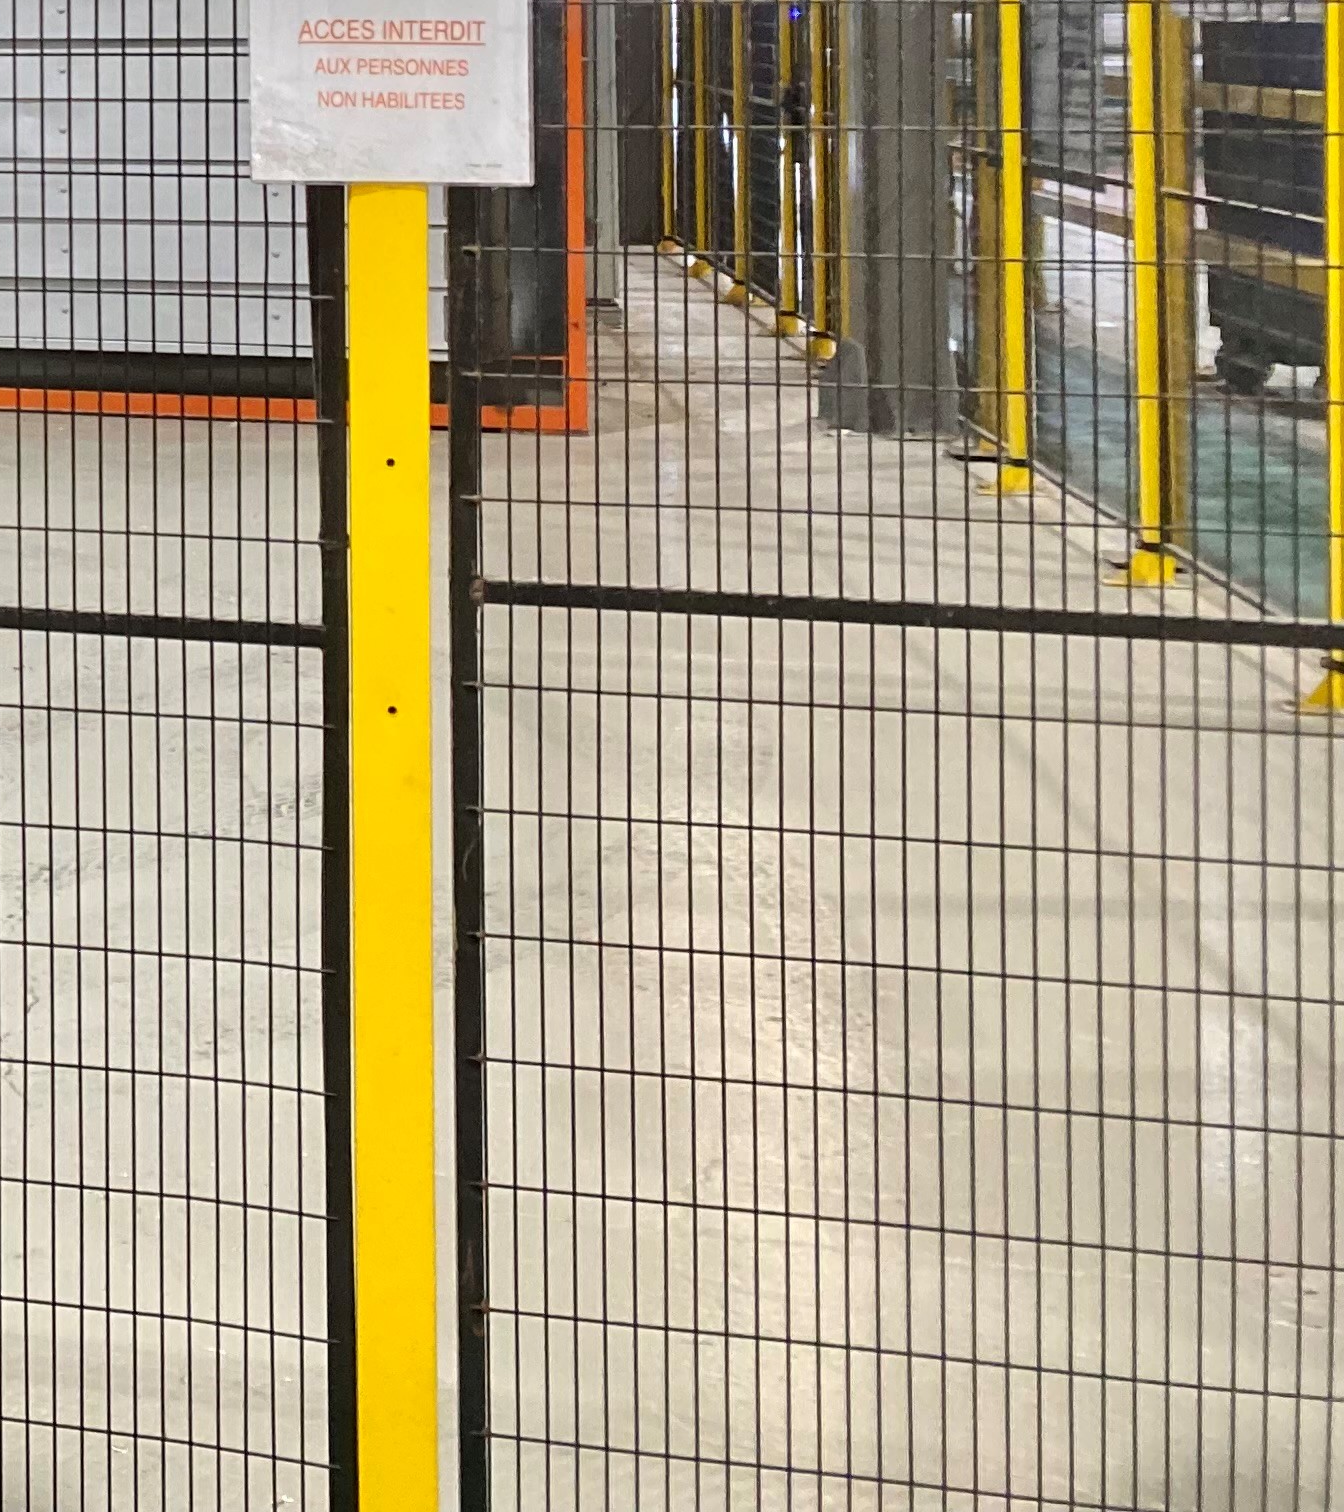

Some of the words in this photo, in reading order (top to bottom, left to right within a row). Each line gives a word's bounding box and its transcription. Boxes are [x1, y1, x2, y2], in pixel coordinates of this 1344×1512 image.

[299, 19, 375, 41] ACCES
[383, 20, 486, 42] INTERDIT
[315, 58, 351, 75] AUX
[357, 58, 469, 76] PERSONNES
[317, 91, 357, 109] NON
[362, 92, 466, 110] HABILITEES
